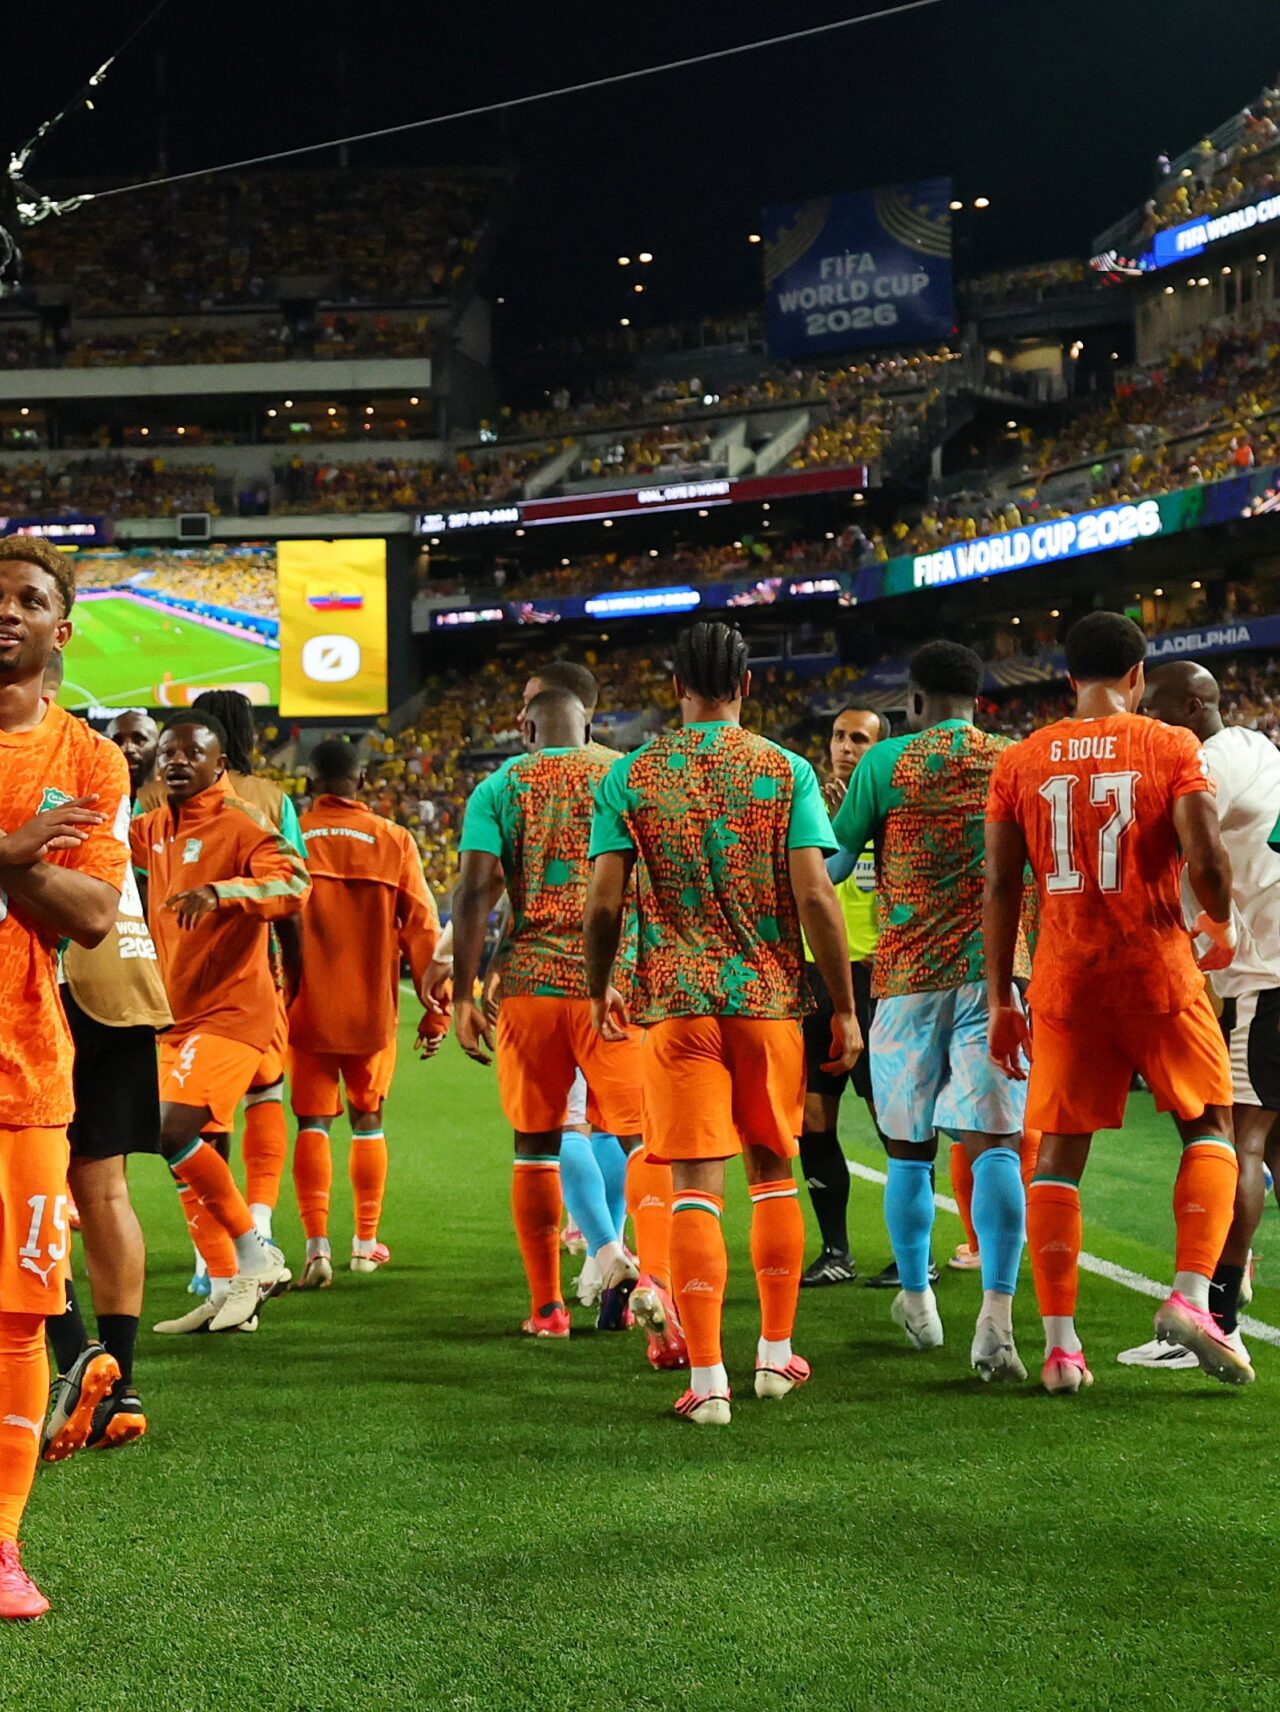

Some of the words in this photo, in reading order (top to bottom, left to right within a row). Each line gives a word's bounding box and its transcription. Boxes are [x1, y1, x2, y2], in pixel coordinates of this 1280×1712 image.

[1176, 224, 1207, 252] FIFA
[1206, 205, 1257, 241] WORLD
[1257, 194, 1280, 223] CU
[821, 252, 877, 280] FIFA
[778, 279, 869, 313] WORLD
[873, 272, 930, 299] CUP
[806, 303, 898, 336] 2026
[913, 550, 957, 588] FIFA
[955, 532, 1031, 578] WORLD
[1031, 521, 1077, 561] CUP
[1077, 500, 1160, 551] 2026
[302, 634, 361, 683] 0
[1147, 625, 1251, 657] ILADELPHIA
[1038, 770, 1143, 896] 17
[118, 936, 158, 961] 202
[20, 1194, 67, 1261] 15
